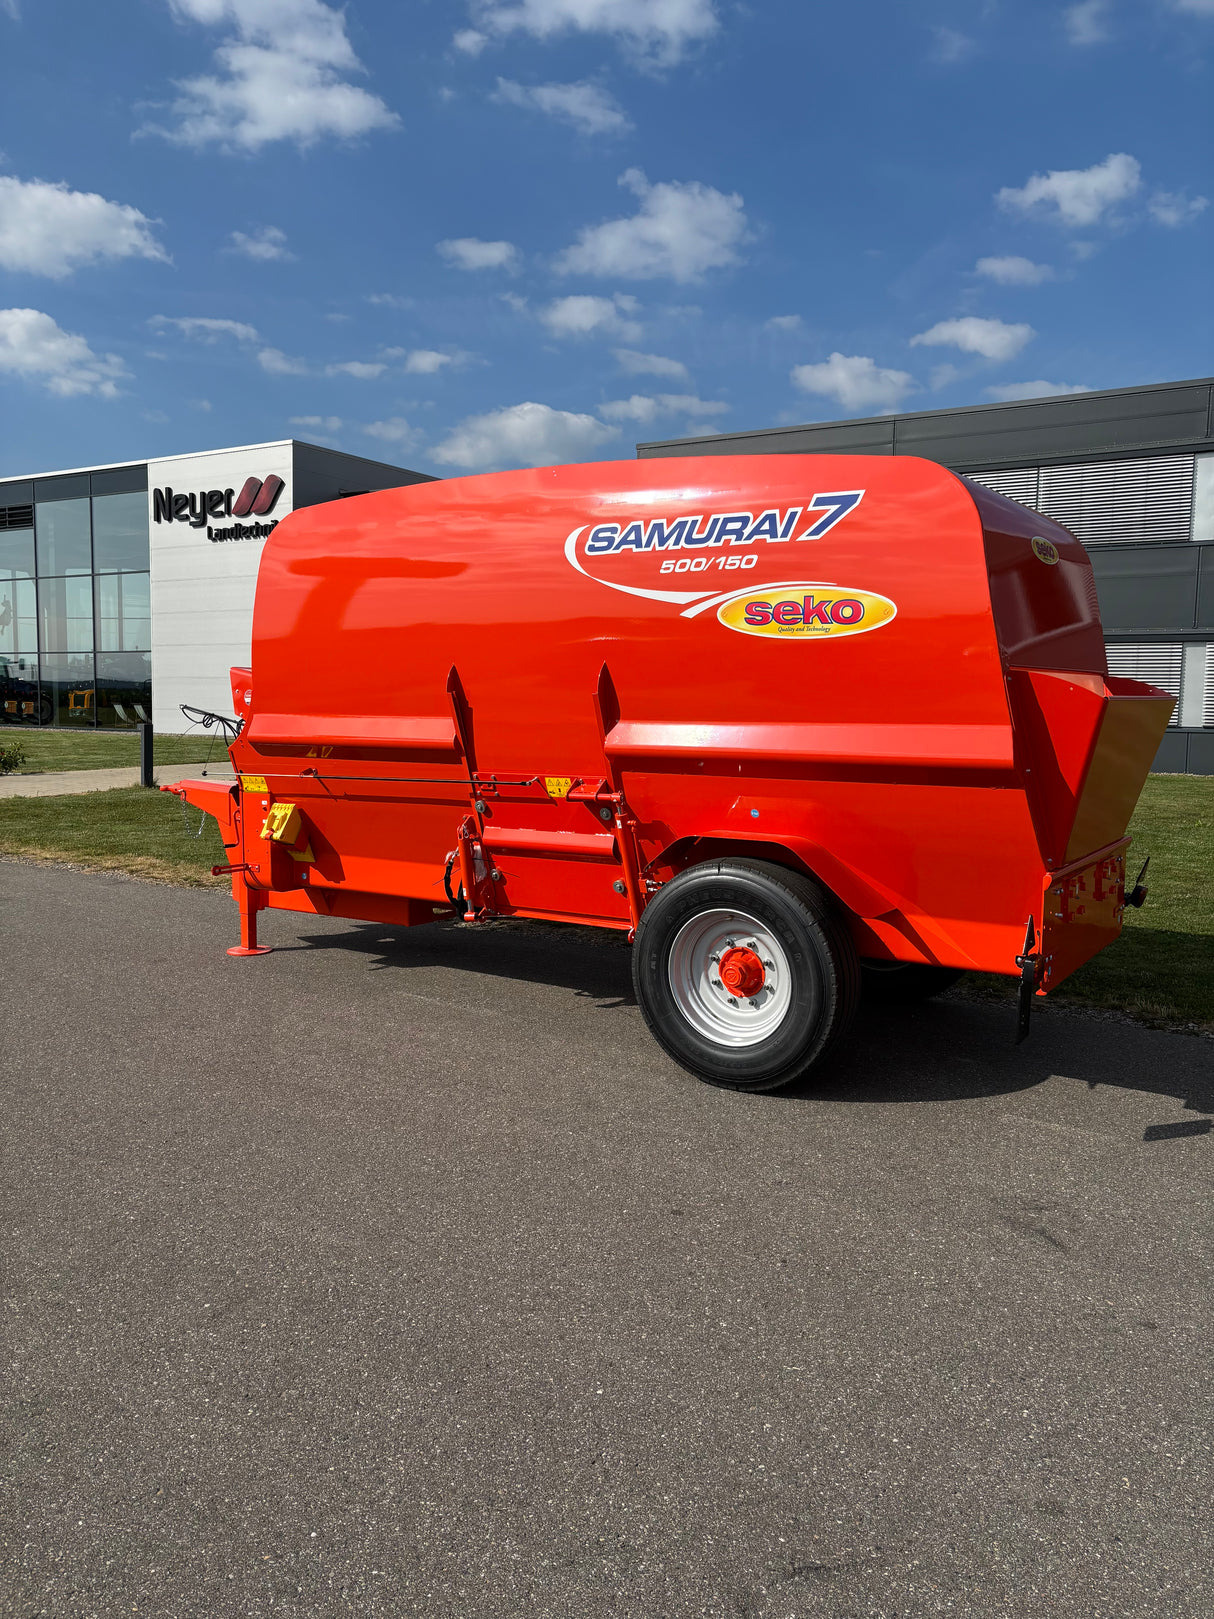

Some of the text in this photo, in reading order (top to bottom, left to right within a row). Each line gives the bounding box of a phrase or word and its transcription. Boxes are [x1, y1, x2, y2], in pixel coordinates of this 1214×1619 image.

[153, 487, 235, 528] Neyer
[207, 519, 279, 543] Landtechni
[585, 489, 866, 556] SAMURAI 7
[659, 555, 759, 574] 500/150
[744, 595, 864, 625] seko
[777, 625, 795, 634] Quality
[806, 625, 831, 634] Technology
